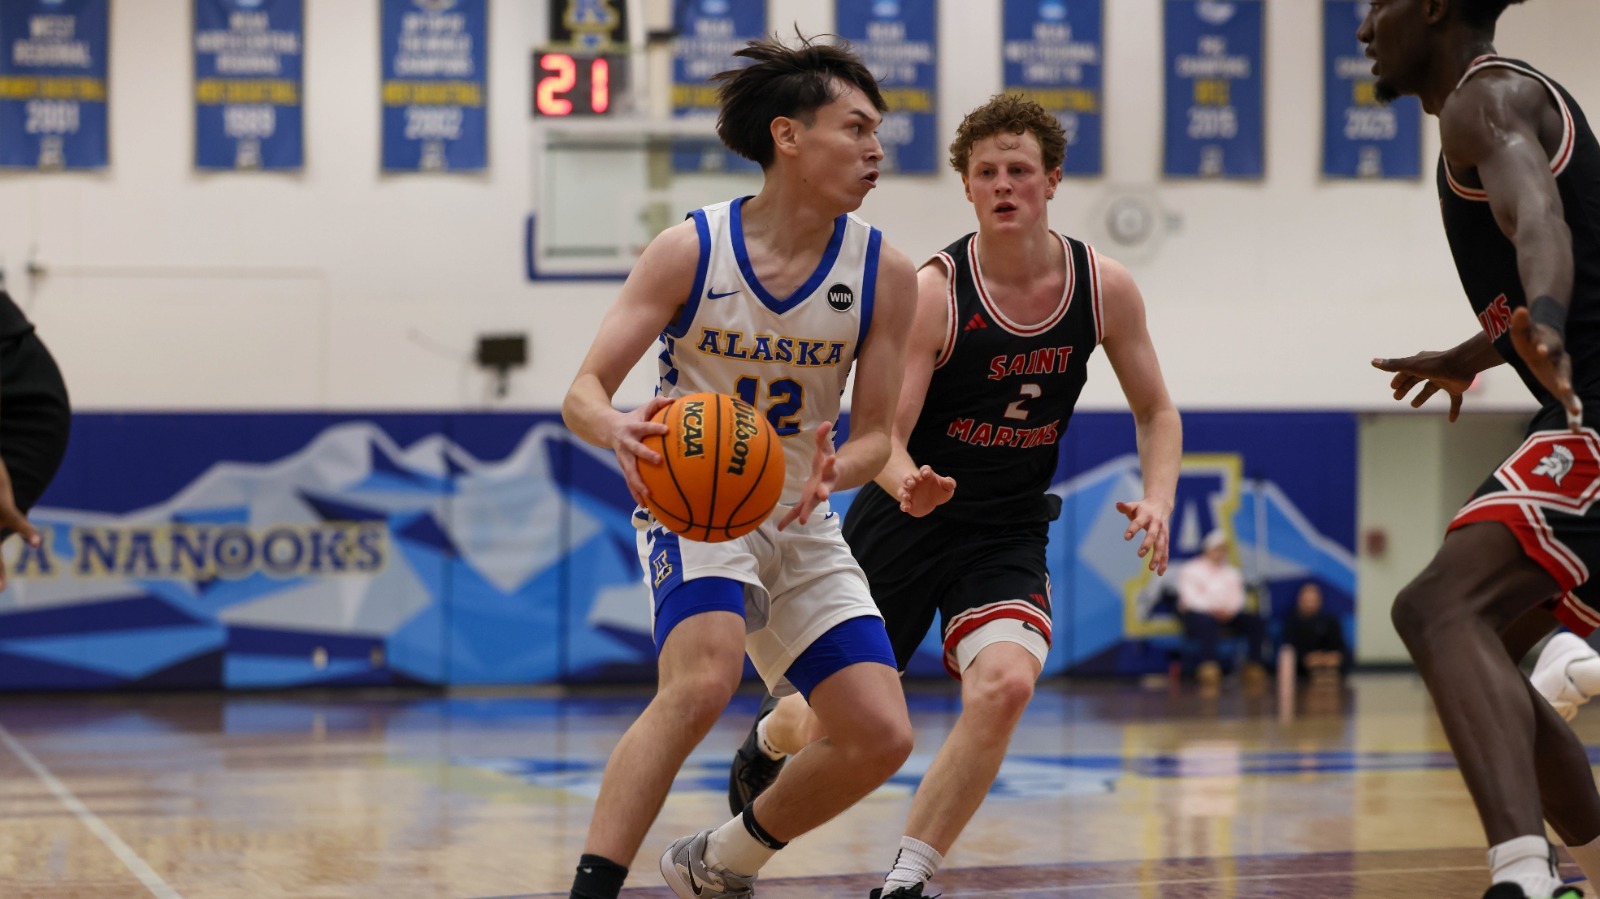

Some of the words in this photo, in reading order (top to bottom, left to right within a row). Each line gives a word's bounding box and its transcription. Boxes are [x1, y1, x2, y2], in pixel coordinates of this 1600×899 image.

[537, 54, 609, 115] 21
[828, 291, 852, 304] WIN
[697, 326, 847, 368] ALASKA
[988, 345, 1073, 381] SAINT
[732, 374, 806, 438] 12
[1003, 382, 1042, 421] 2
[683, 400, 705, 458] NCAA
[727, 397, 759, 476] Wilson
[946, 415, 1061, 449] MARTINS
[73, 520, 390, 580] NANOOKS
